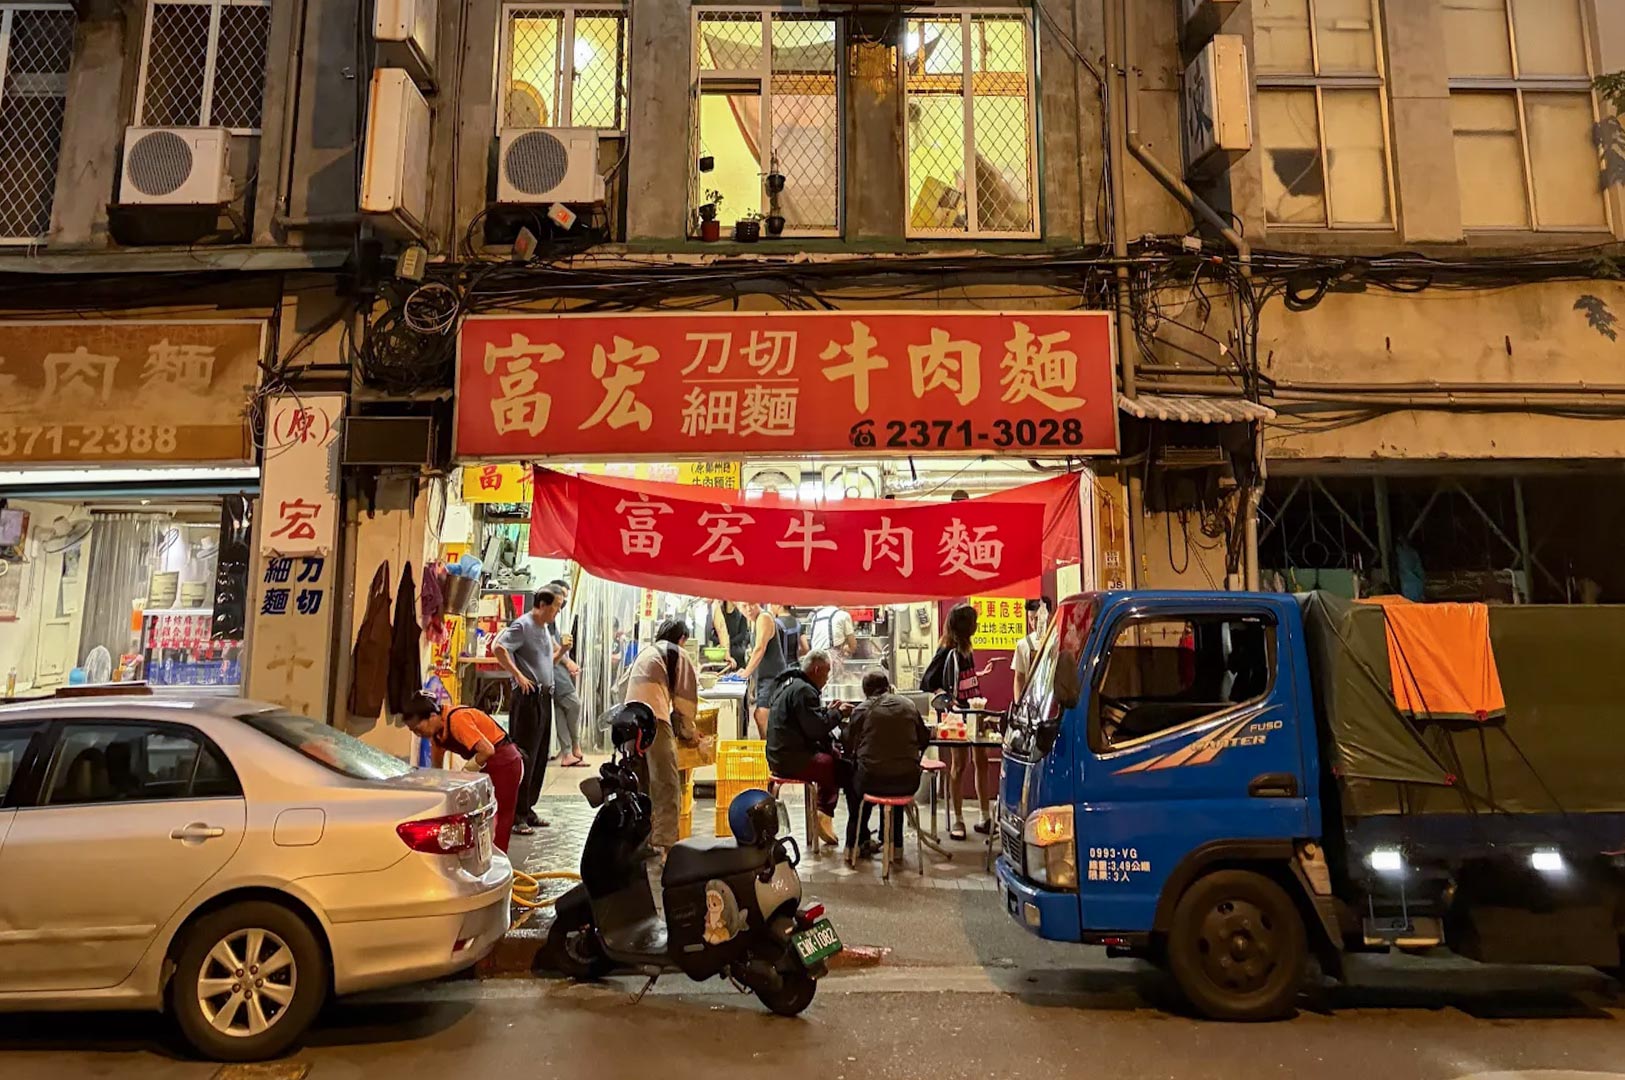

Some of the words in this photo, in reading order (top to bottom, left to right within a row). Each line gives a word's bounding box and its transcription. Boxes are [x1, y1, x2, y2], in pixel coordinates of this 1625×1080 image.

[0, 338, 217, 406] 肉麵
[680, 330, 798, 376] 刀切
[819, 320, 1086, 422] 牛肉麵
[484, 333, 660, 437] 富宏
[680, 384, 799, 438] 細麵
[886, 418, 1084, 448] 2371-3028
[270, 498, 322, 540] 宏
[614, 492, 1004, 580] 富宏牛肉麵
[260, 557, 294, 615] 細麵
[297, 557, 325, 615] 刀切
[977, 622, 997, 634] 土地
[1250, 720, 1283, 733] FUSO
